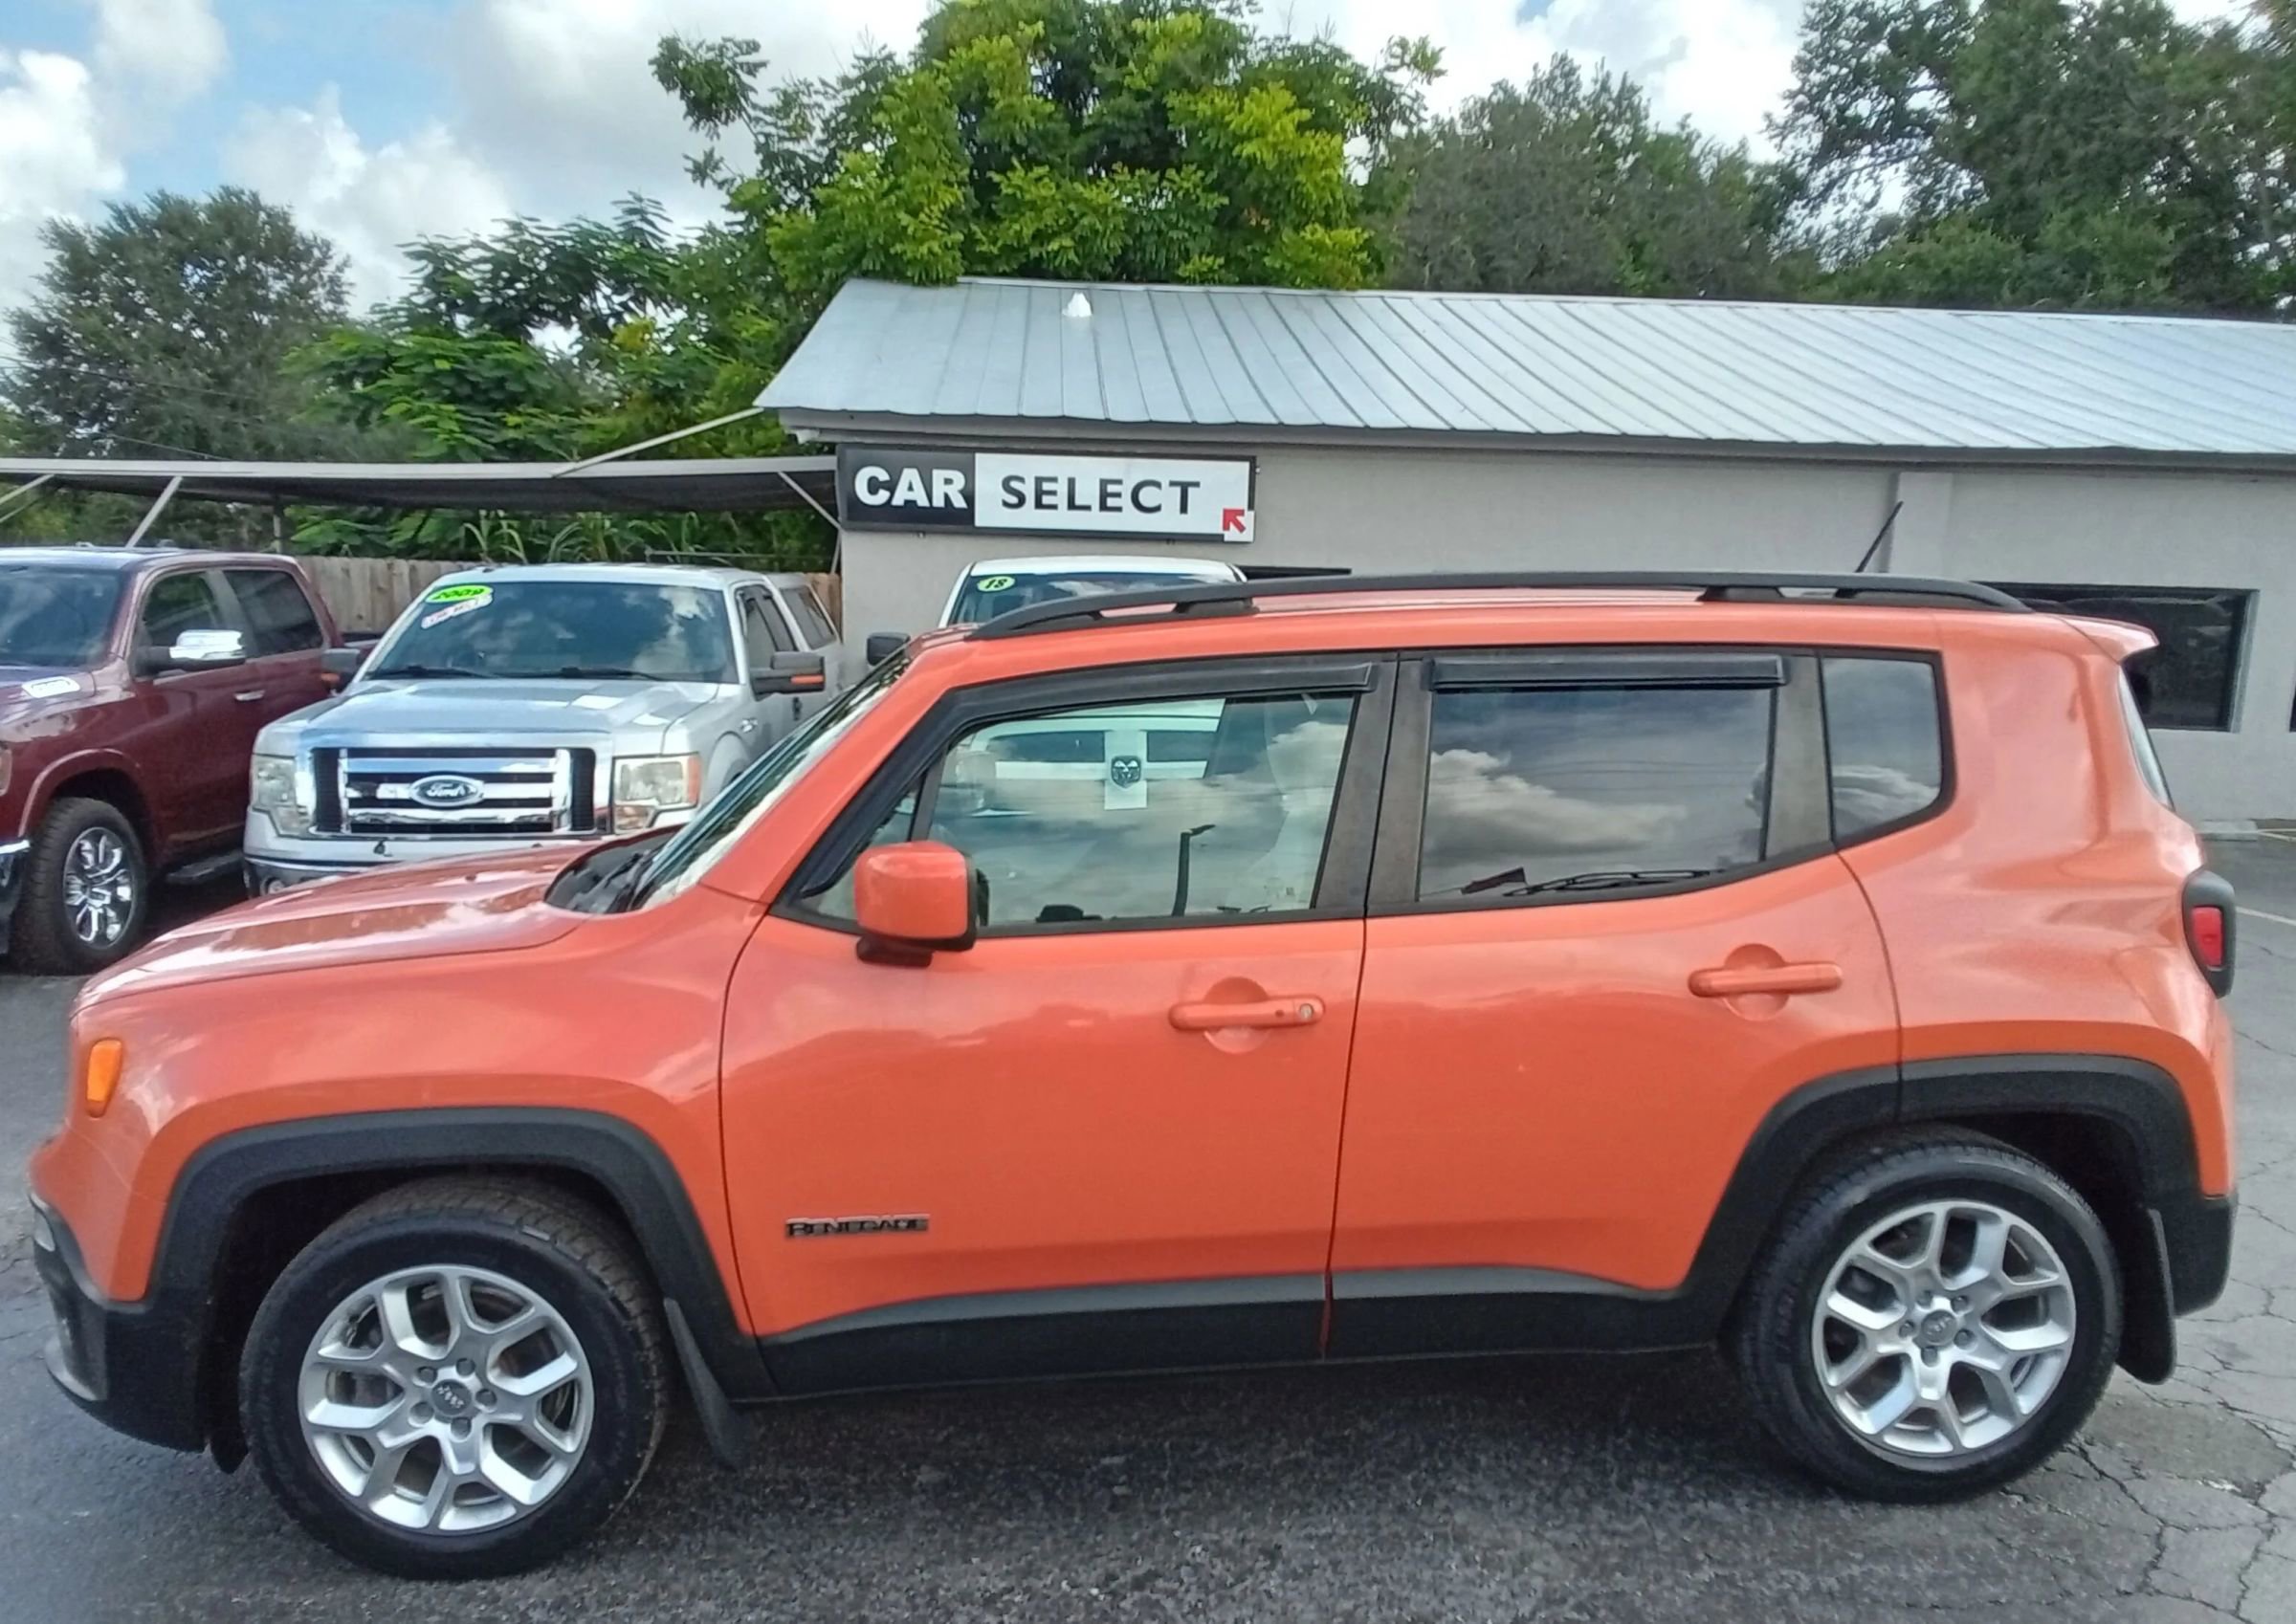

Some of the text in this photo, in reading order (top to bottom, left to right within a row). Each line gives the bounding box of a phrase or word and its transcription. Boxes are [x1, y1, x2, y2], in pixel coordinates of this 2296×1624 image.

[854, 466, 1201, 515] CAR SELECT
[426, 781, 466, 799] Ford
[785, 1214, 930, 1239] RENEGADE
